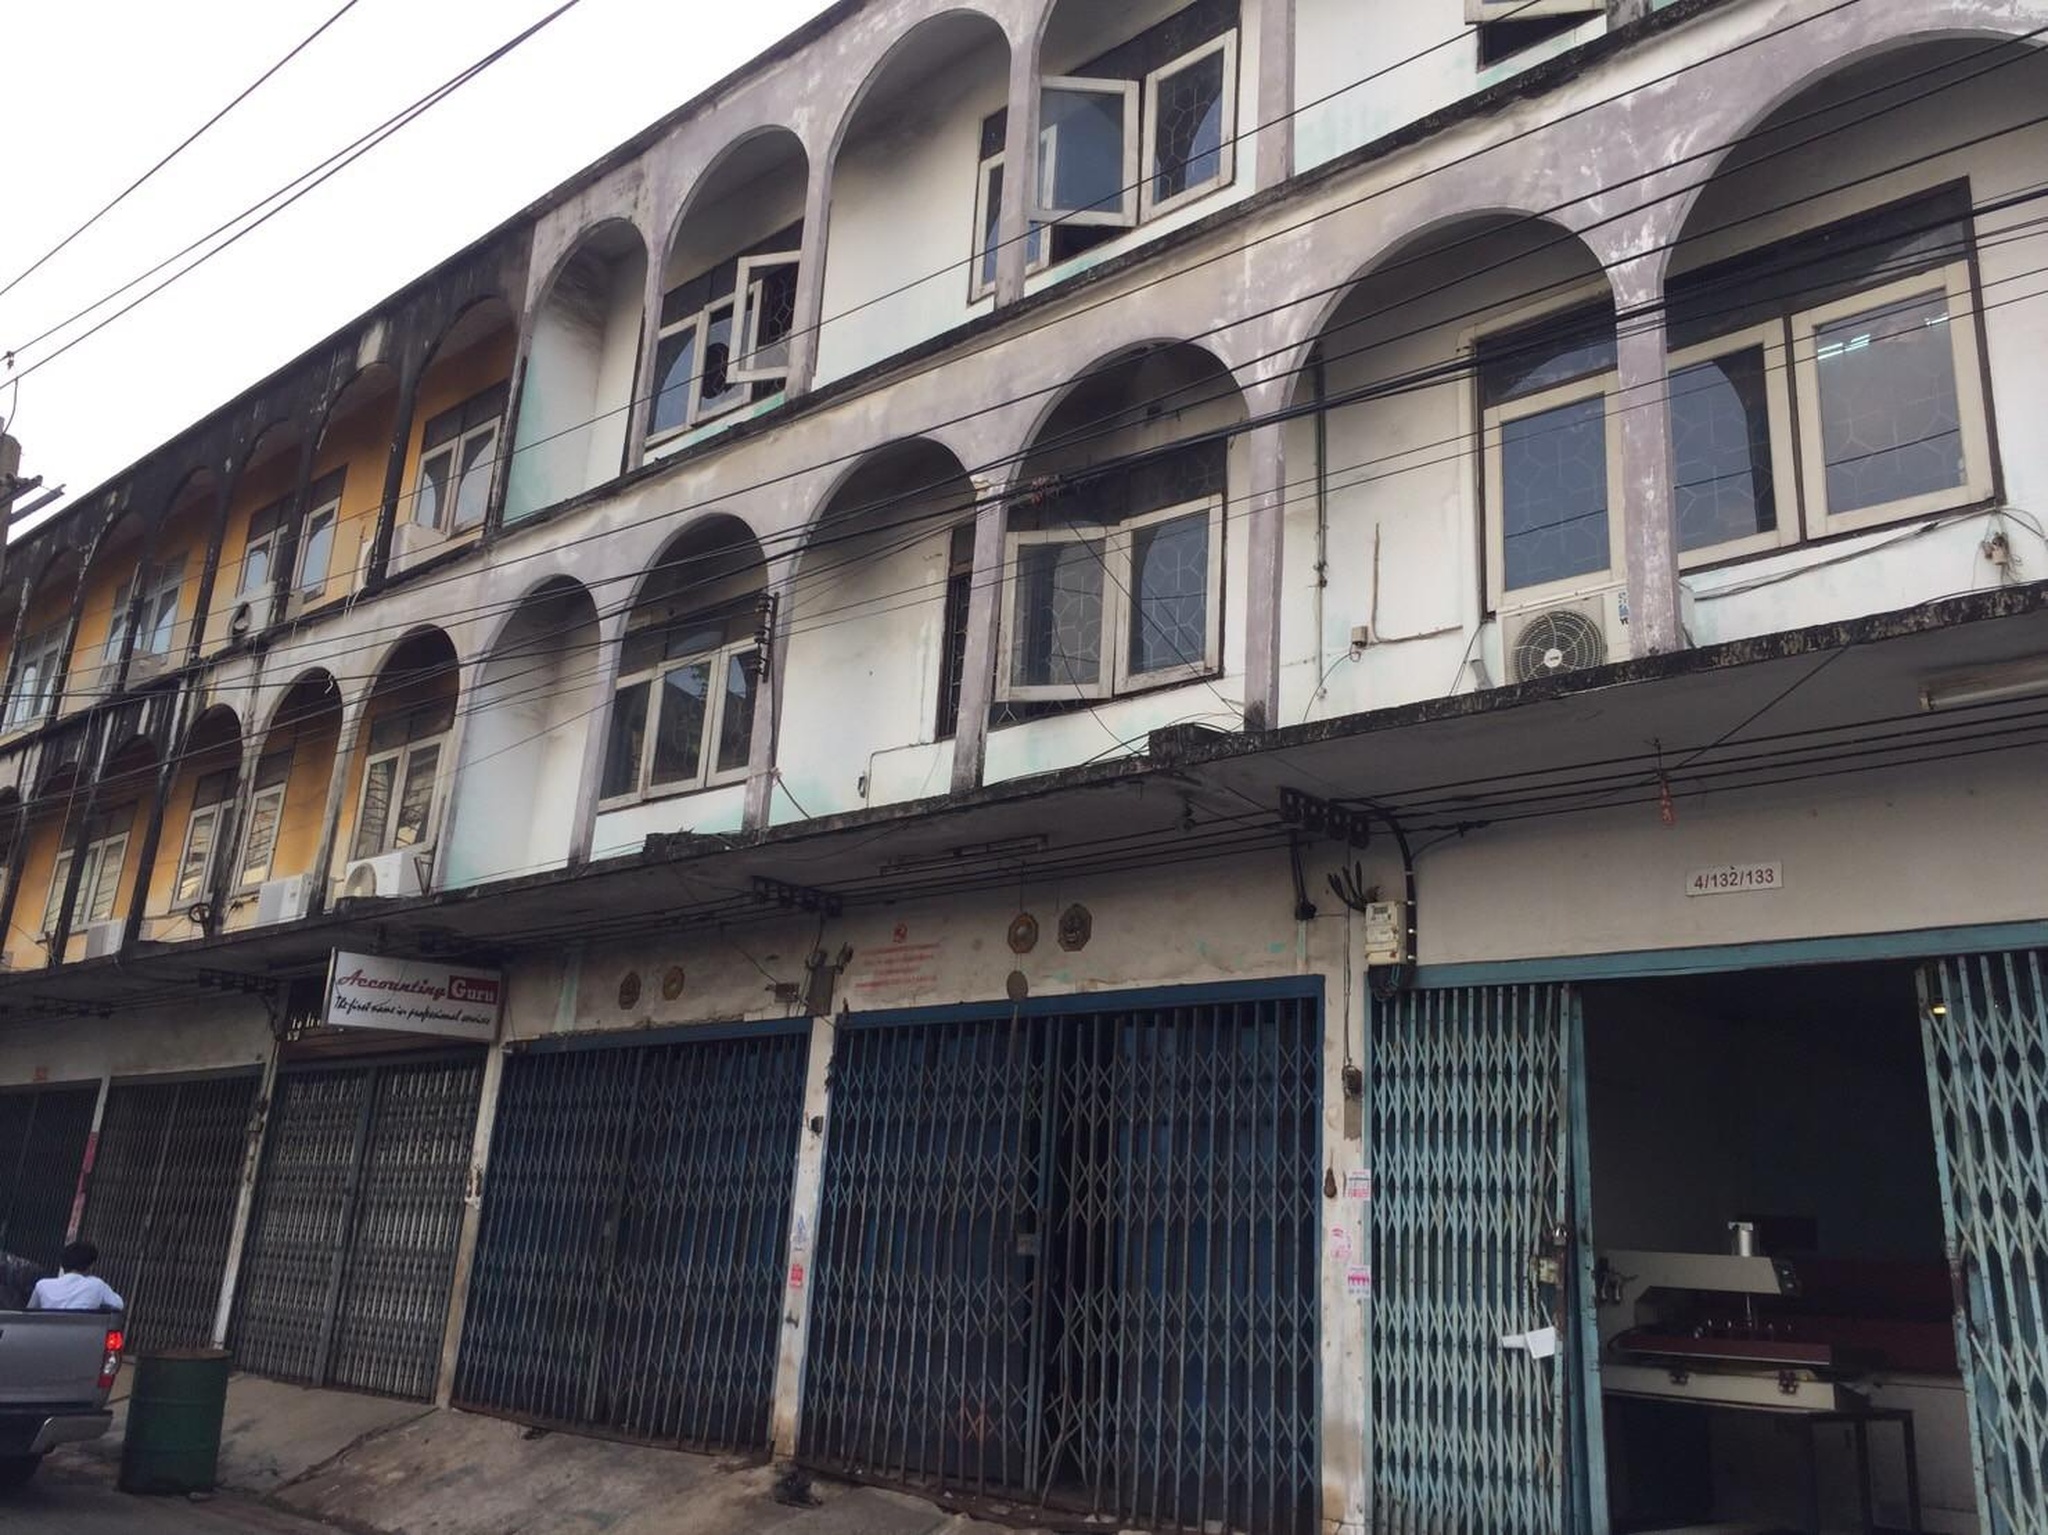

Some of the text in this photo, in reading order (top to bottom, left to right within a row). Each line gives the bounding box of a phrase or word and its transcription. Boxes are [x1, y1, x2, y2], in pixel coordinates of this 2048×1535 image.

[1694, 868, 1774, 889] 4/132/133
[338, 968, 495, 1002] Accounting Guru
[334, 995, 348, 1009] The
[347, 997, 371, 1015] first
[396, 1005, 407, 1015] in
[407, 1006, 463, 1022] professional
